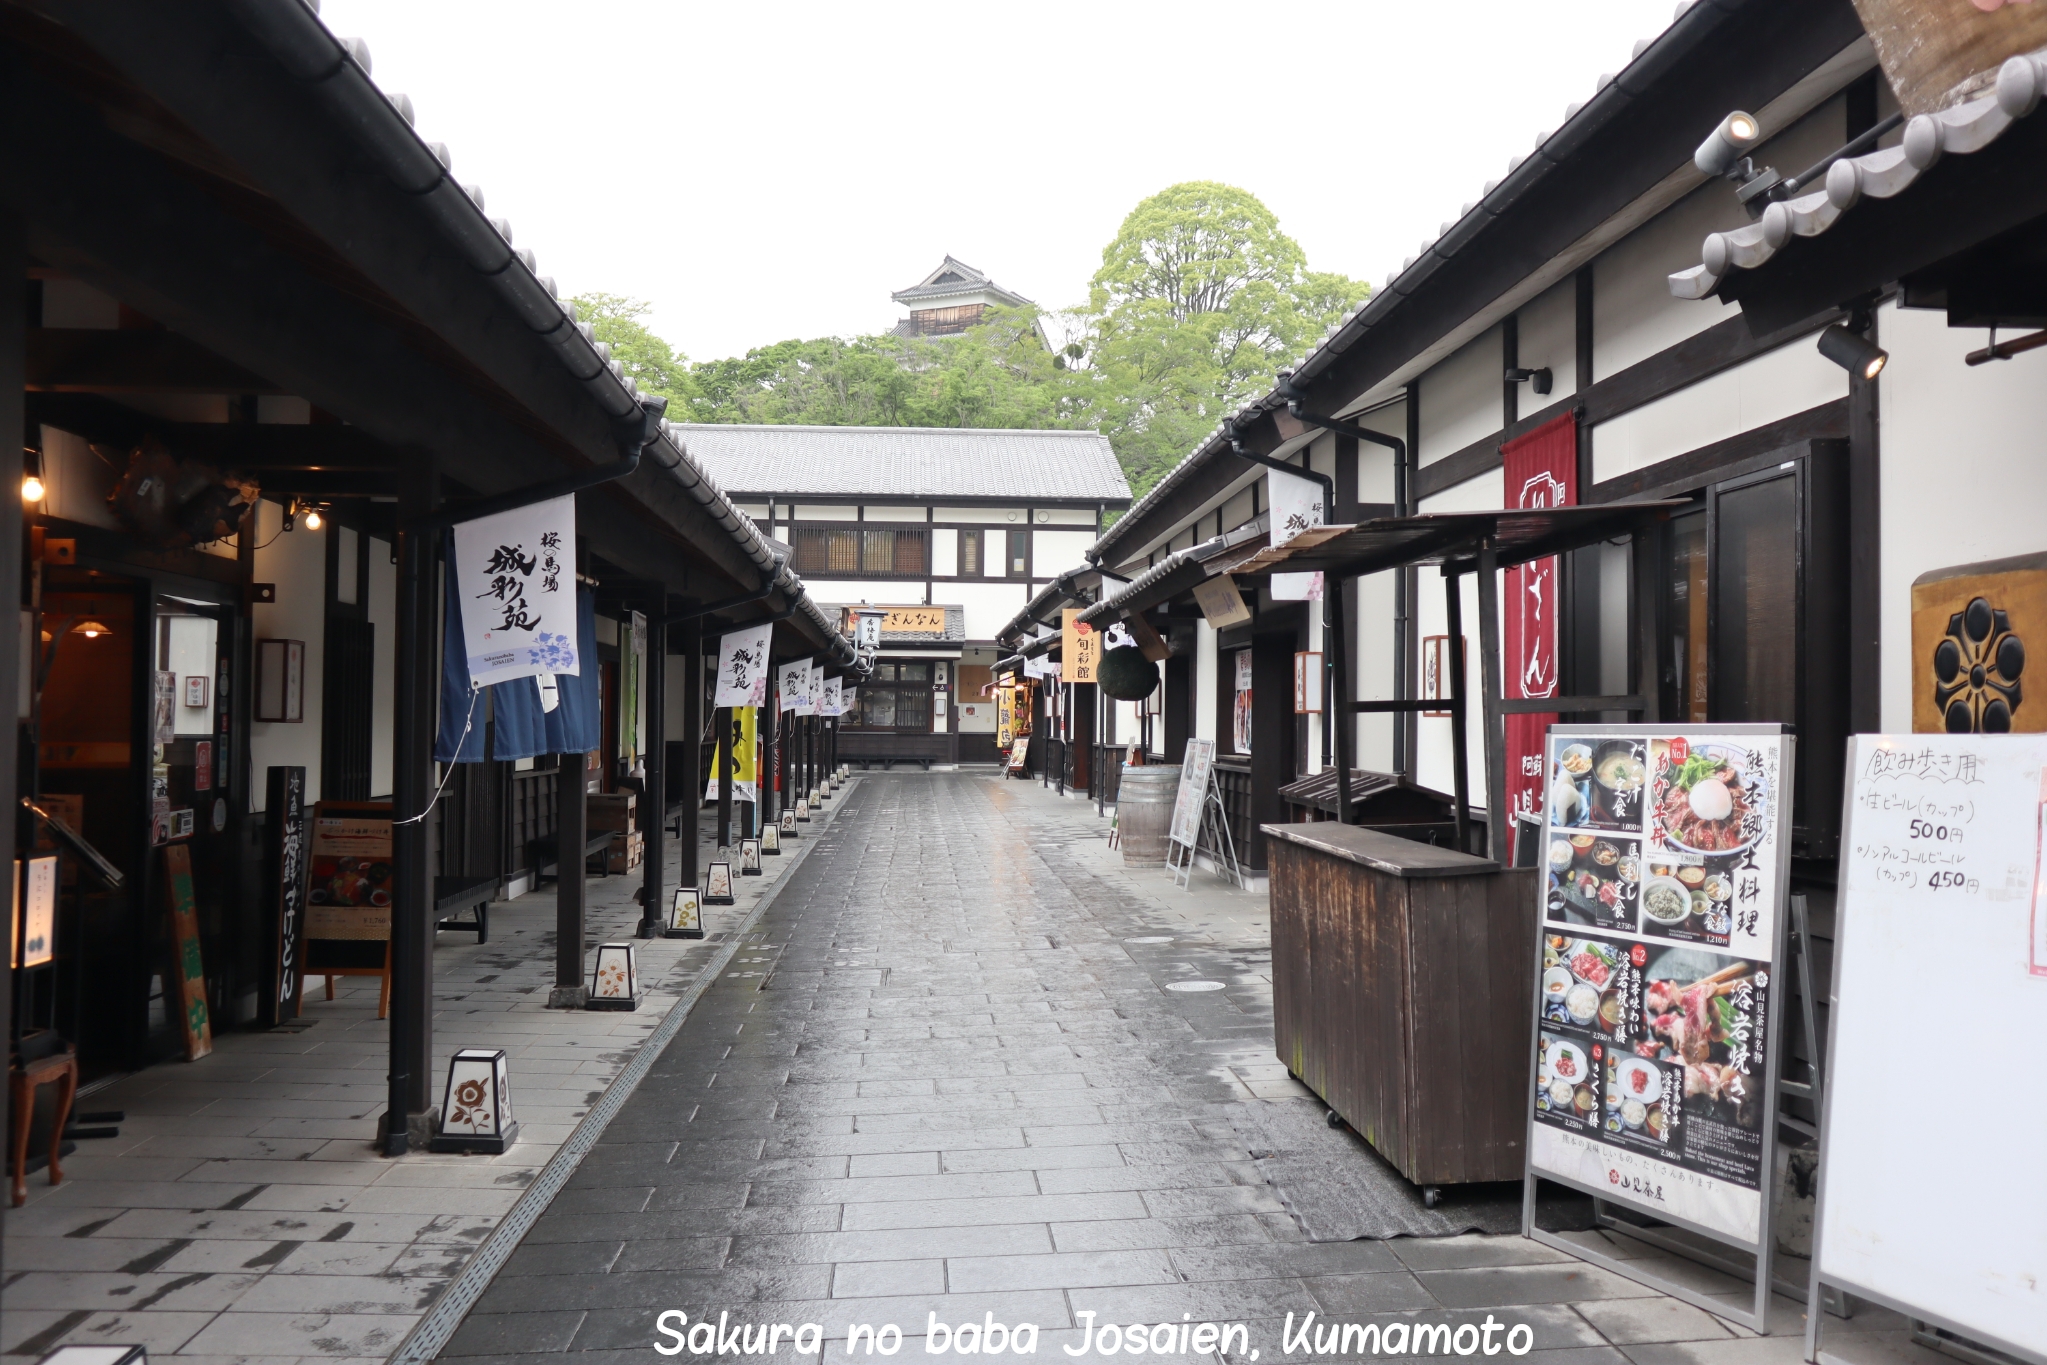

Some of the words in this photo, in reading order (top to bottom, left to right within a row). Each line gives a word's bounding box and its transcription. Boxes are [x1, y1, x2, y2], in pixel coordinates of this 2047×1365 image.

[540, 531, 562, 594] 桜の馬場
[475, 543, 542, 632] 城彩苑
[891, 612, 940, 626] ぎんなん
[491, 657, 515, 667] JOSAIEN
[725, 648, 755, 690] 城彩苑
[1077, 637, 1090, 679] 旬彩館
[1522, 753, 1543, 777] 阿蘇
[1864, 746, 1978, 781] 飲み歩き用
[1612, 776, 1628, 818] 定食
[1650, 751, 1670, 850] あか牛丼
[1765, 746, 1779, 846] 熊本を堪能する
[1737, 749, 1766, 938] 熊本郷土料理
[1909, 818, 1964, 844] 500円
[1625, 842, 1640, 901] 馬刺し
[1928, 870, 1980, 895] 450円
[1611, 880, 1627, 920] 定食
[1703, 900, 1716, 931] 定食
[1616, 921, 1636, 931] 2,750円
[1706, 935, 1728, 945] 1,210円
[1614, 951, 1631, 1045] 溶岩焼き膳
[1629, 968, 1641, 1034] 熊本味わい
[1729, 979, 1754, 1104] 溶岩焼き
[1754, 990, 1766, 1065] 山見茶屋名物
[1588, 1062, 1600, 1129] さくら膳
[1659, 1071, 1673, 1143] 溶岩焼き膳
[1671, 1067, 1682, 1128] 熊本あか牛
[1660, 1149, 1681, 1161] 2,500円
[1620, 1175, 1666, 1202] 山見茶屋
